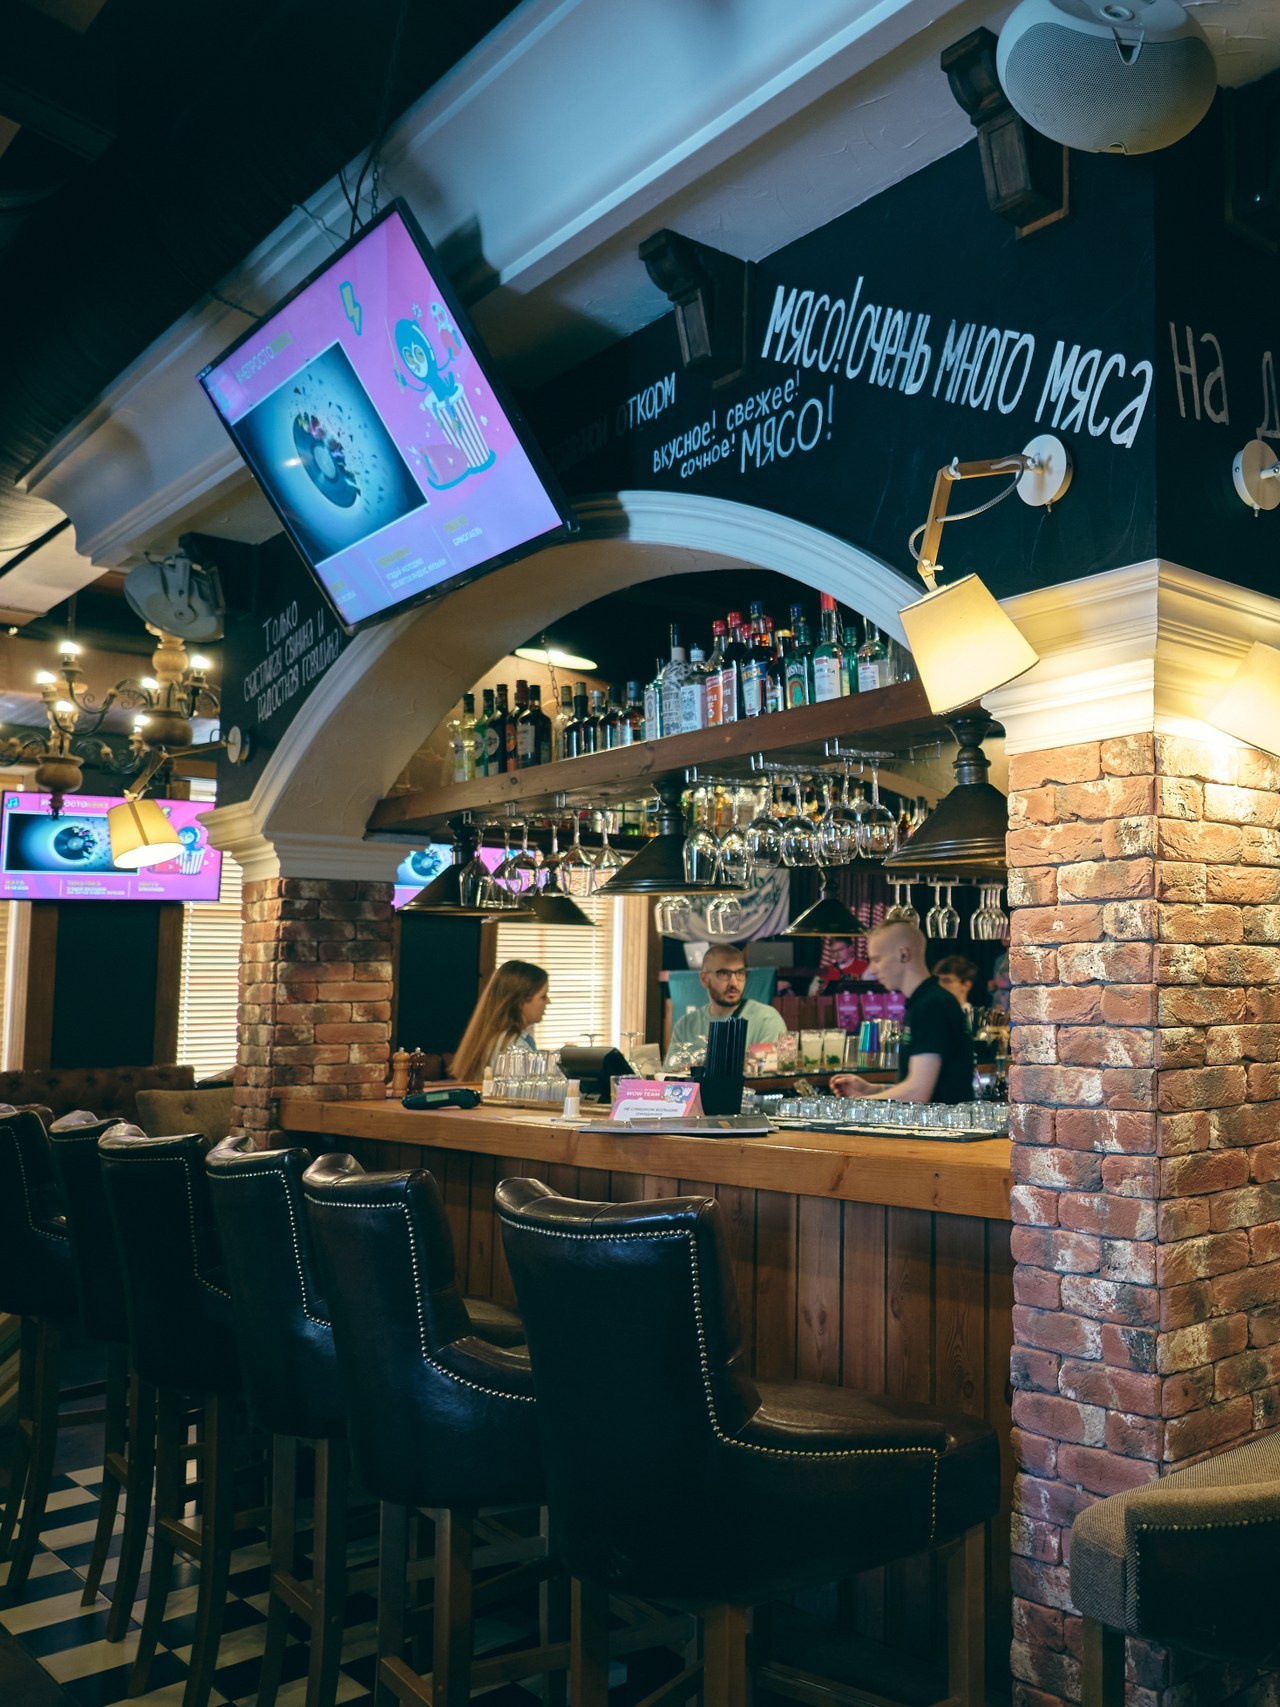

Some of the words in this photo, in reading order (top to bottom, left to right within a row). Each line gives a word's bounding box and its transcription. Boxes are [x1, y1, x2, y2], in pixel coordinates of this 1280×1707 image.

[653, 409, 716, 474] вкусное!
[726, 369, 800, 432] свежее!
[680, 432, 736, 479] сочное!
